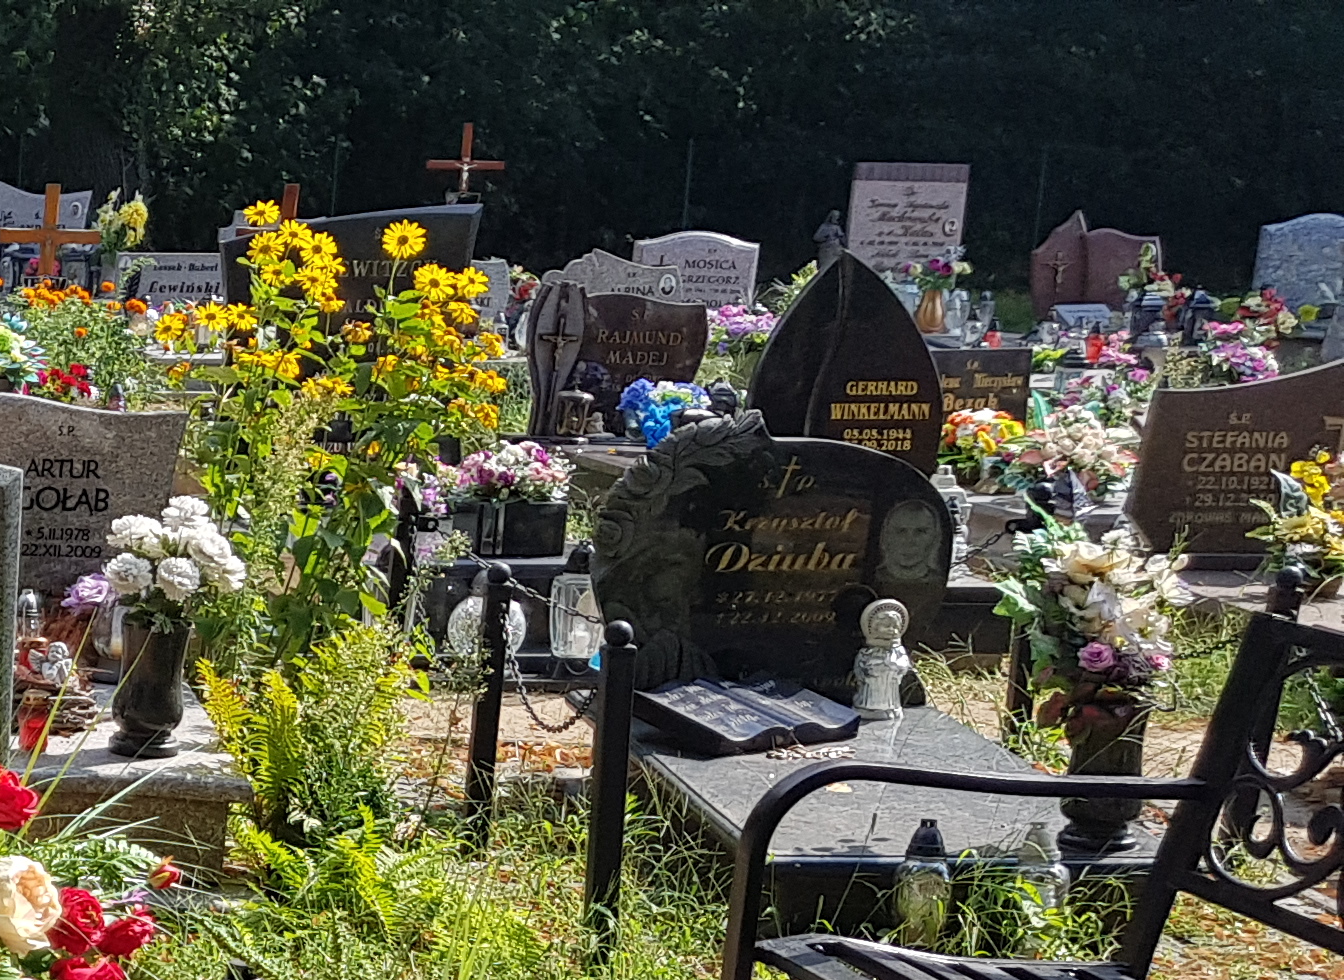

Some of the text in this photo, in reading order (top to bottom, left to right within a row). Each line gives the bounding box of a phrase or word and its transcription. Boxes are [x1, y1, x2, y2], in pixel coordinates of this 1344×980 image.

[596, 328, 683, 346] RAJMUND
[605, 350, 669, 366] MADEJ
[845, 380, 919, 396] GERHARD
[830, 402, 931, 420] WINKELMANN
[1184, 430, 1289, 449] STEFANIA
[24, 458, 101, 479] ARTUR
[1182, 452, 1286, 473] CZABAN
[716, 507, 859, 533] Krzysztof
[705, 541, 858, 573] Dziuba
